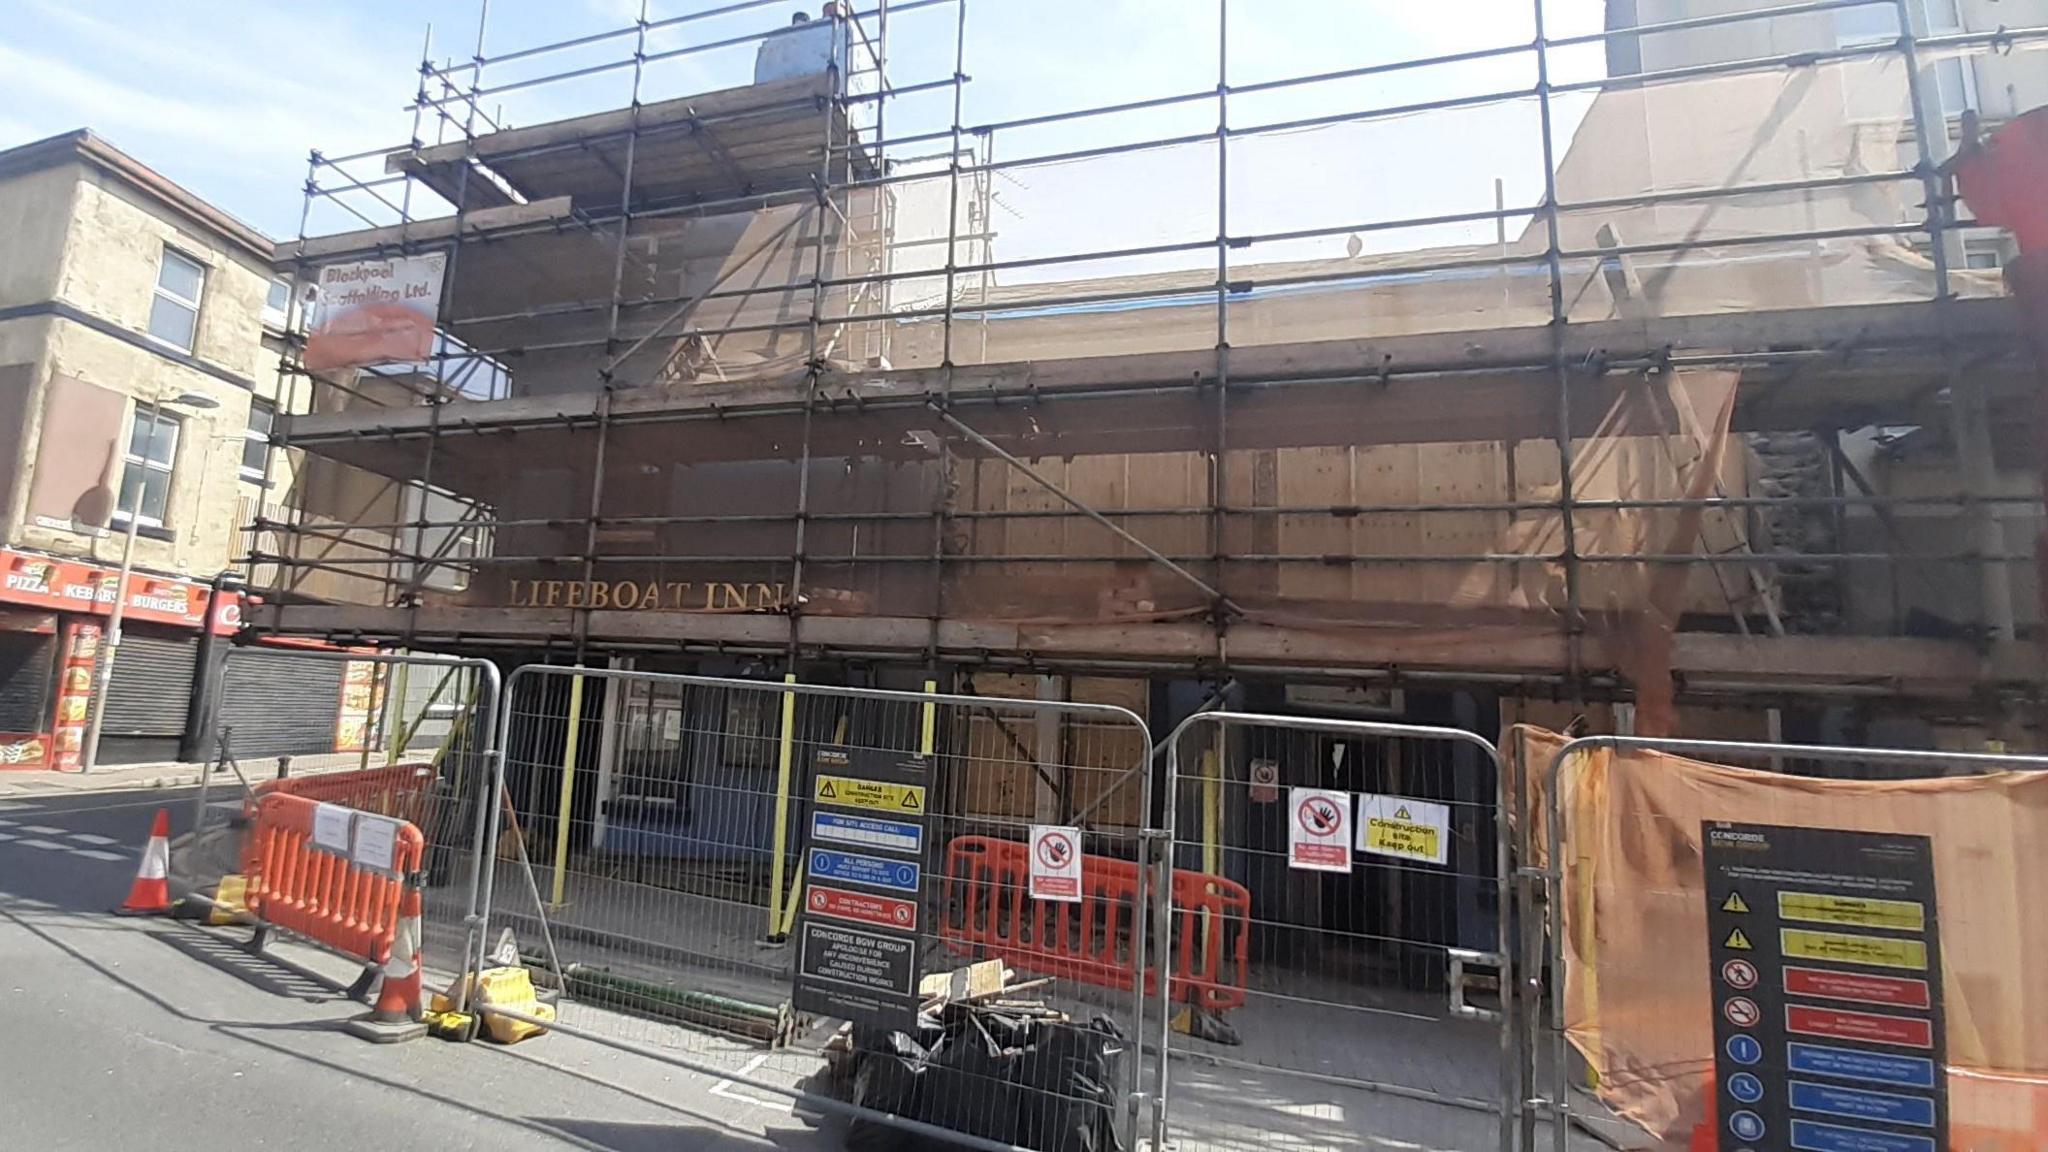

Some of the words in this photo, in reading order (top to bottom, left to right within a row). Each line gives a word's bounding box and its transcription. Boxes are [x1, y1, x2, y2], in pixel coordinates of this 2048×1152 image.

[326, 262, 394, 284] Blackpool
[405, 282, 431, 298] Ltd.
[6, 574, 49, 593] PIZZA
[132, 595, 188, 613] BURGERS
[510, 579, 691, 609] LIFEBOAT
[705, 582, 785, 611] INN
[1369, 818, 1435, 835] Construction
[1378, 839, 1404, 850] Keep
[1407, 845, 1424, 853] out
[855, 937, 876, 948] BGW
[877, 941, 906, 953] GROUP
